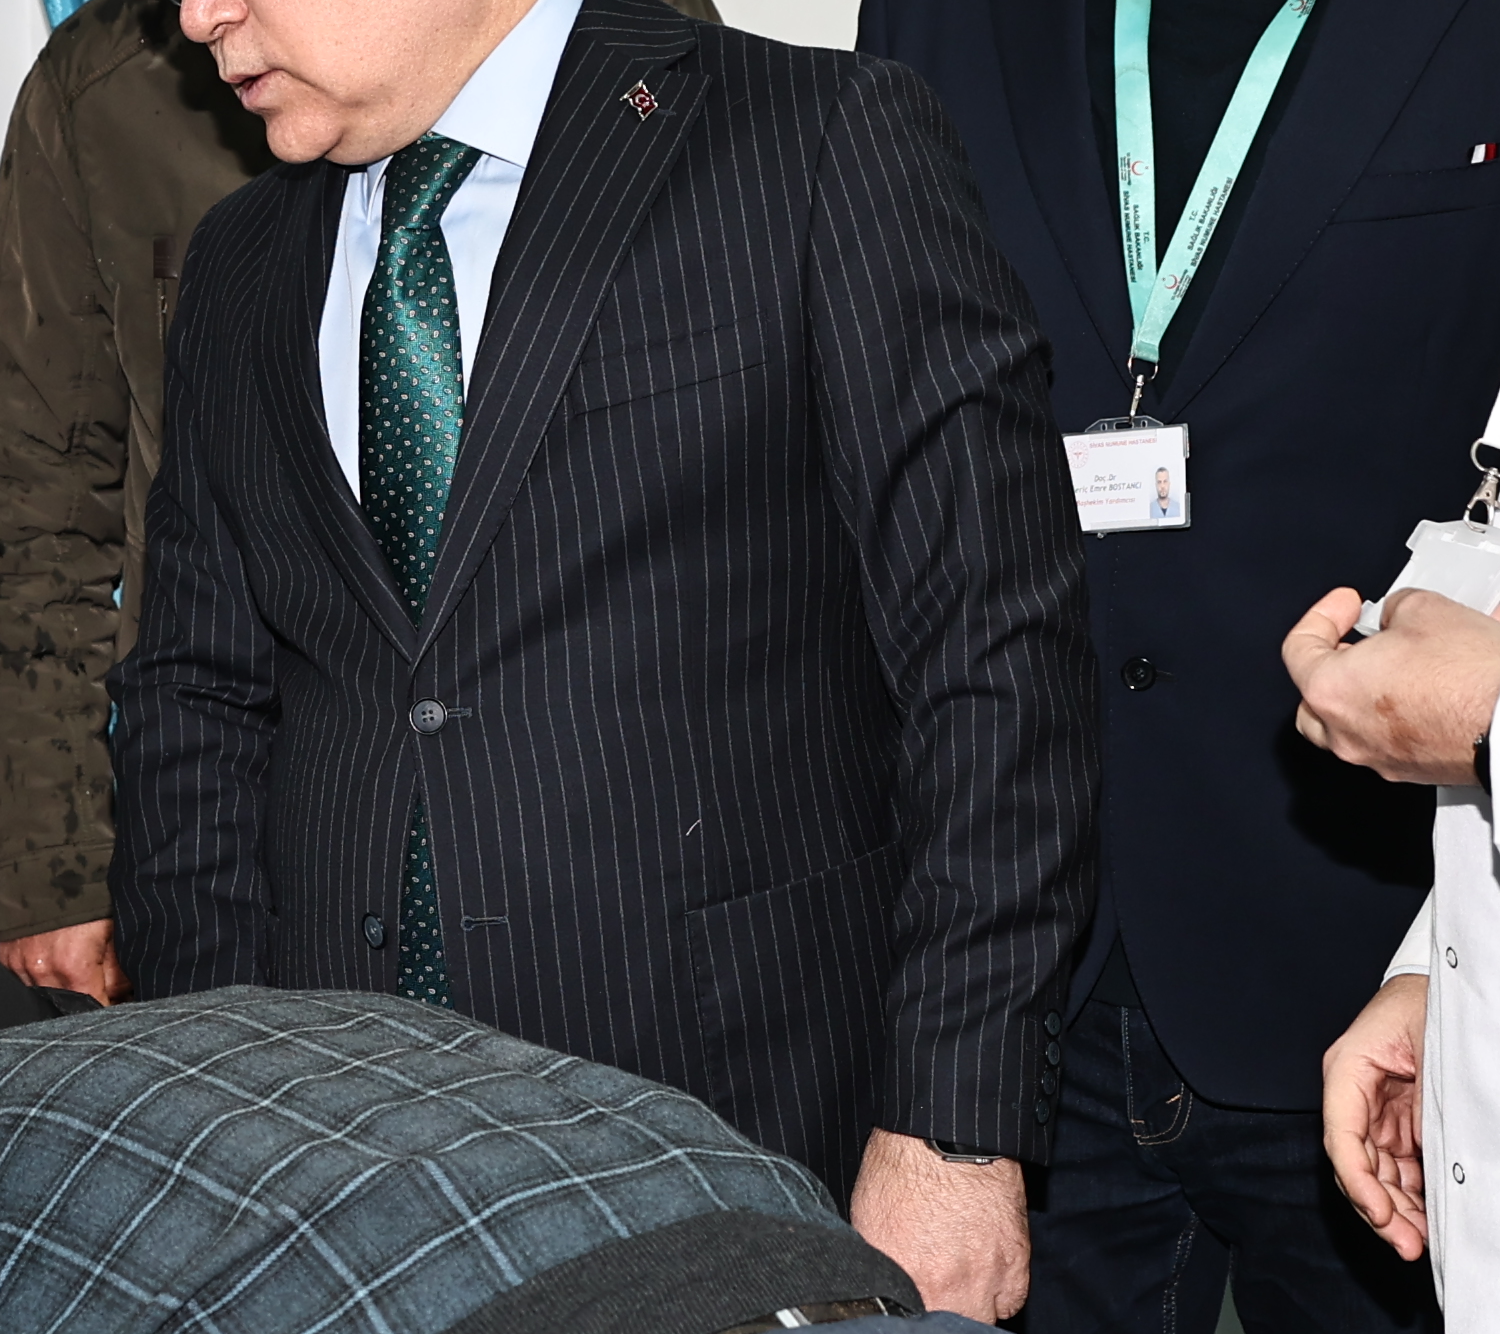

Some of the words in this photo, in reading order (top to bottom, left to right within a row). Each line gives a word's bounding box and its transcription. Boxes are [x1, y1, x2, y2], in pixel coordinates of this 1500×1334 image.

[1124, 213, 1132, 242] NUMUNE
[1187, 225, 1201, 251] SAĞLIK
[1198, 187, 1219, 225] BAKANLIĞI
[1190, 247, 1204, 267] SİVAS
[1200, 217, 1216, 247] NUMUNE
[1213, 177, 1233, 216] HASTANESİ
[1127, 244, 1136, 283] HASTANESİ
[1135, 232, 1144, 270] BAKANLIĞI
[1074, 486, 1088, 494] eriç
[1109, 482, 1142, 491] BOSTANCI
[1094, 475, 1106, 483] Doç
